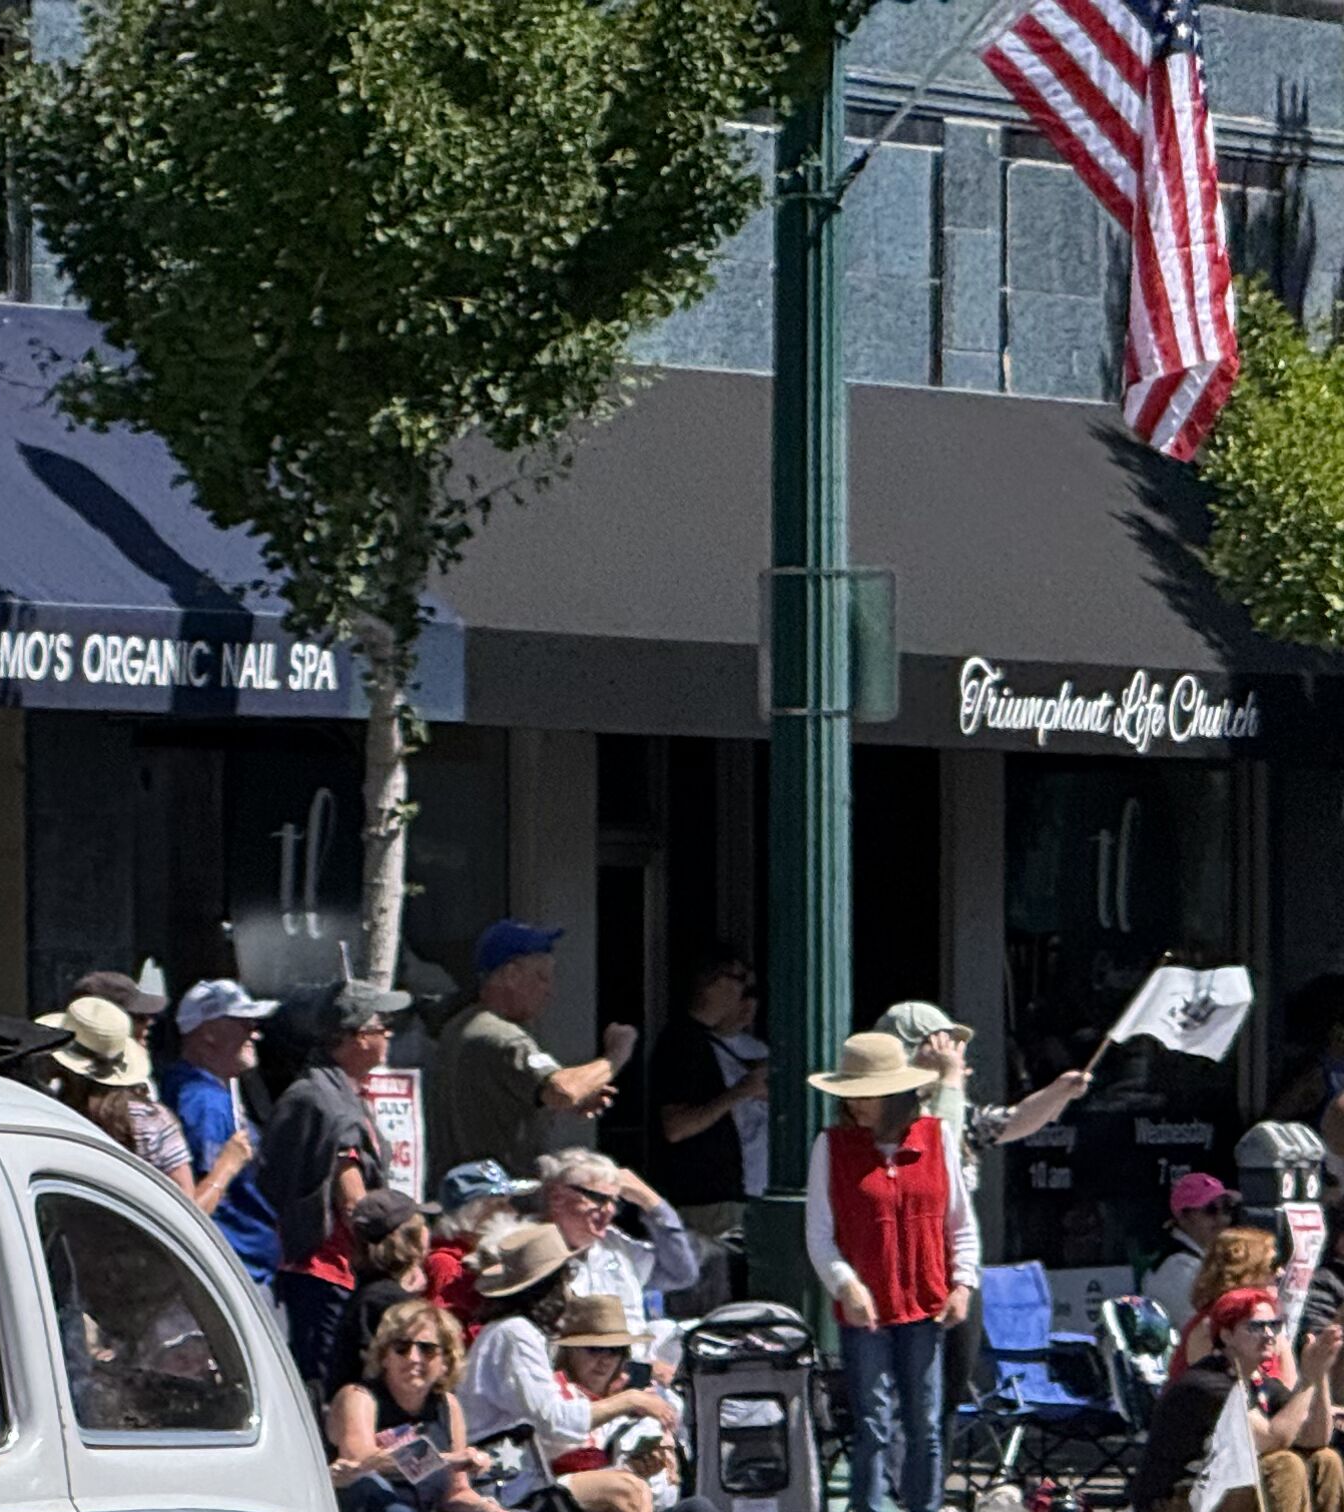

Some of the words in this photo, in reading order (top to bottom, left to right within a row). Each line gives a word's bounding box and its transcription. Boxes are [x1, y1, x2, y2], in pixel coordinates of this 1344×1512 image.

[82, 633, 212, 690] ORGANIC
[220, 641, 278, 692] NAIL
[288, 642, 339, 692] SPA
[958, 655, 1114, 747] Triumphant
[1112, 669, 1166, 754] Life
[1167, 673, 1260, 744] Church
